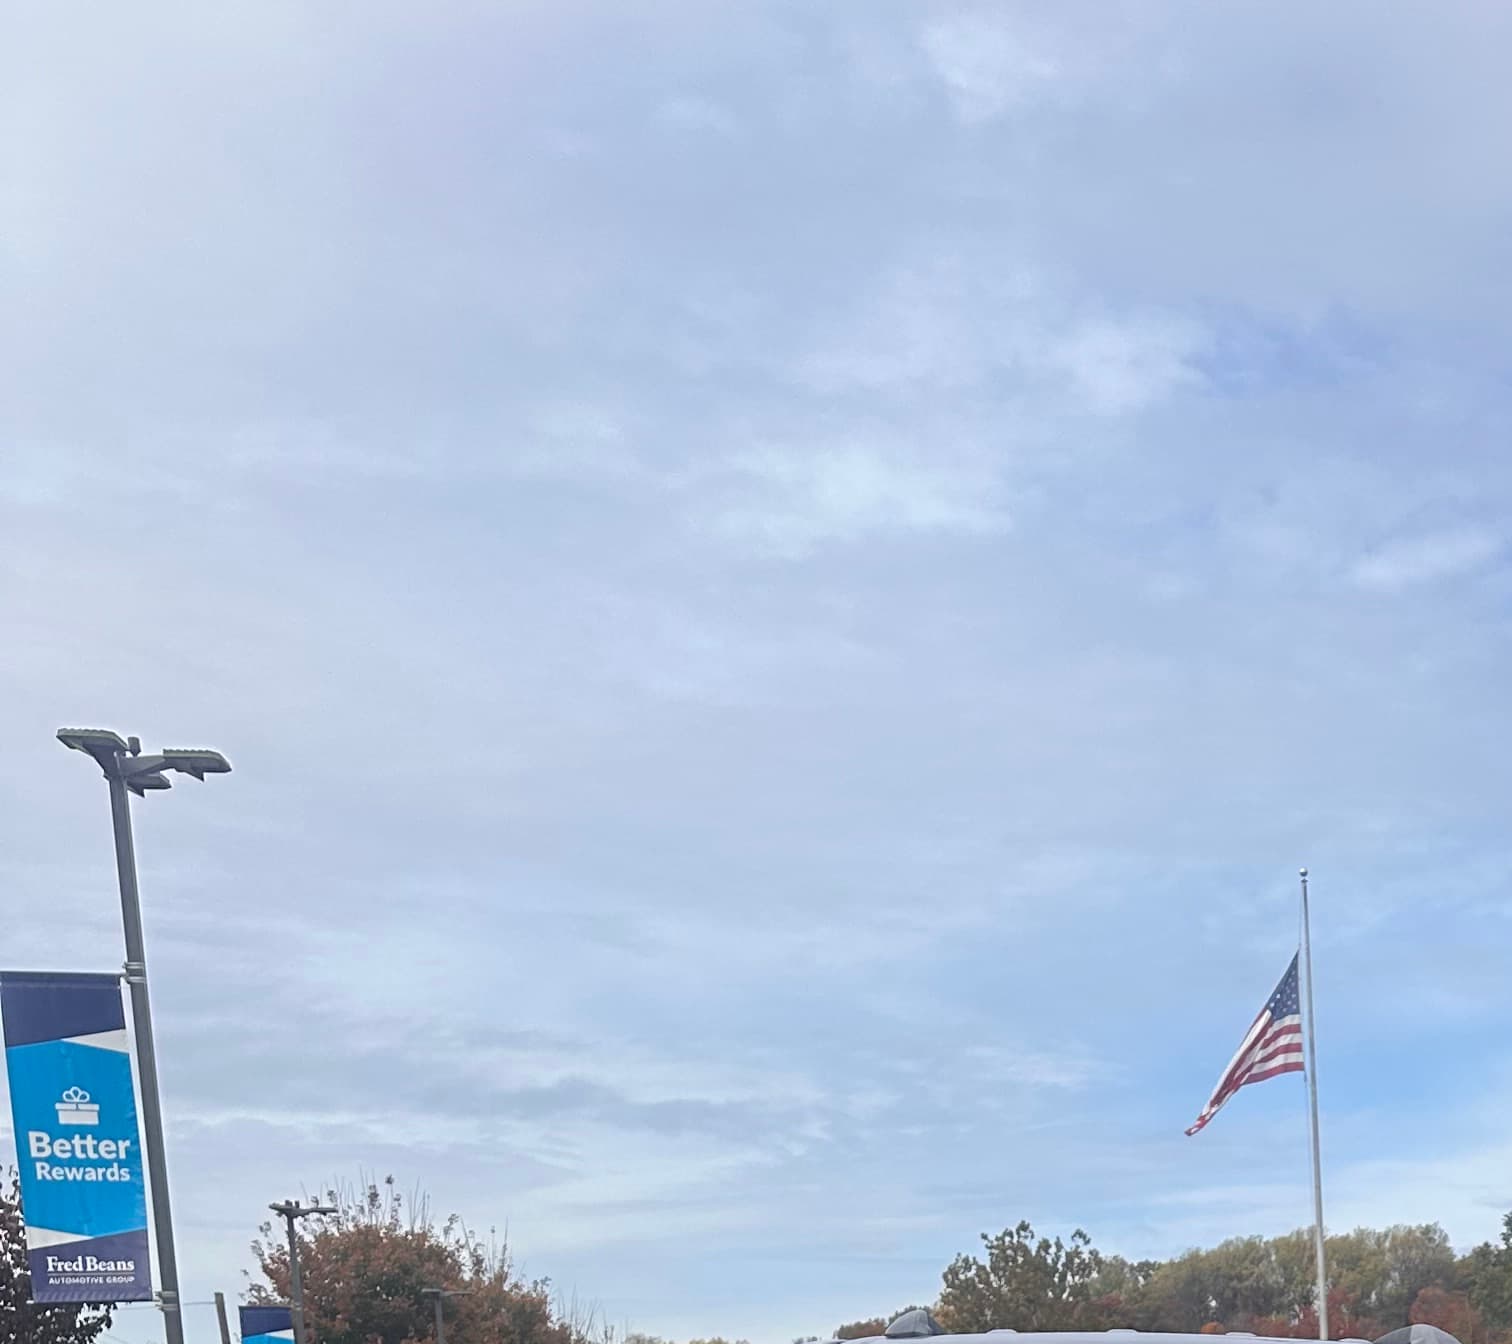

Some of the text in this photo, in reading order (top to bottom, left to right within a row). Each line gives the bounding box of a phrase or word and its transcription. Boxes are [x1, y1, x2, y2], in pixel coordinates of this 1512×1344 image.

[28, 1131, 131, 1159] Better
[35, 1161, 131, 1182] Rewards
[46, 1255, 135, 1272] Fred Beans
[48, 1275, 136, 1285] AUTOMOTIVE GROUP
